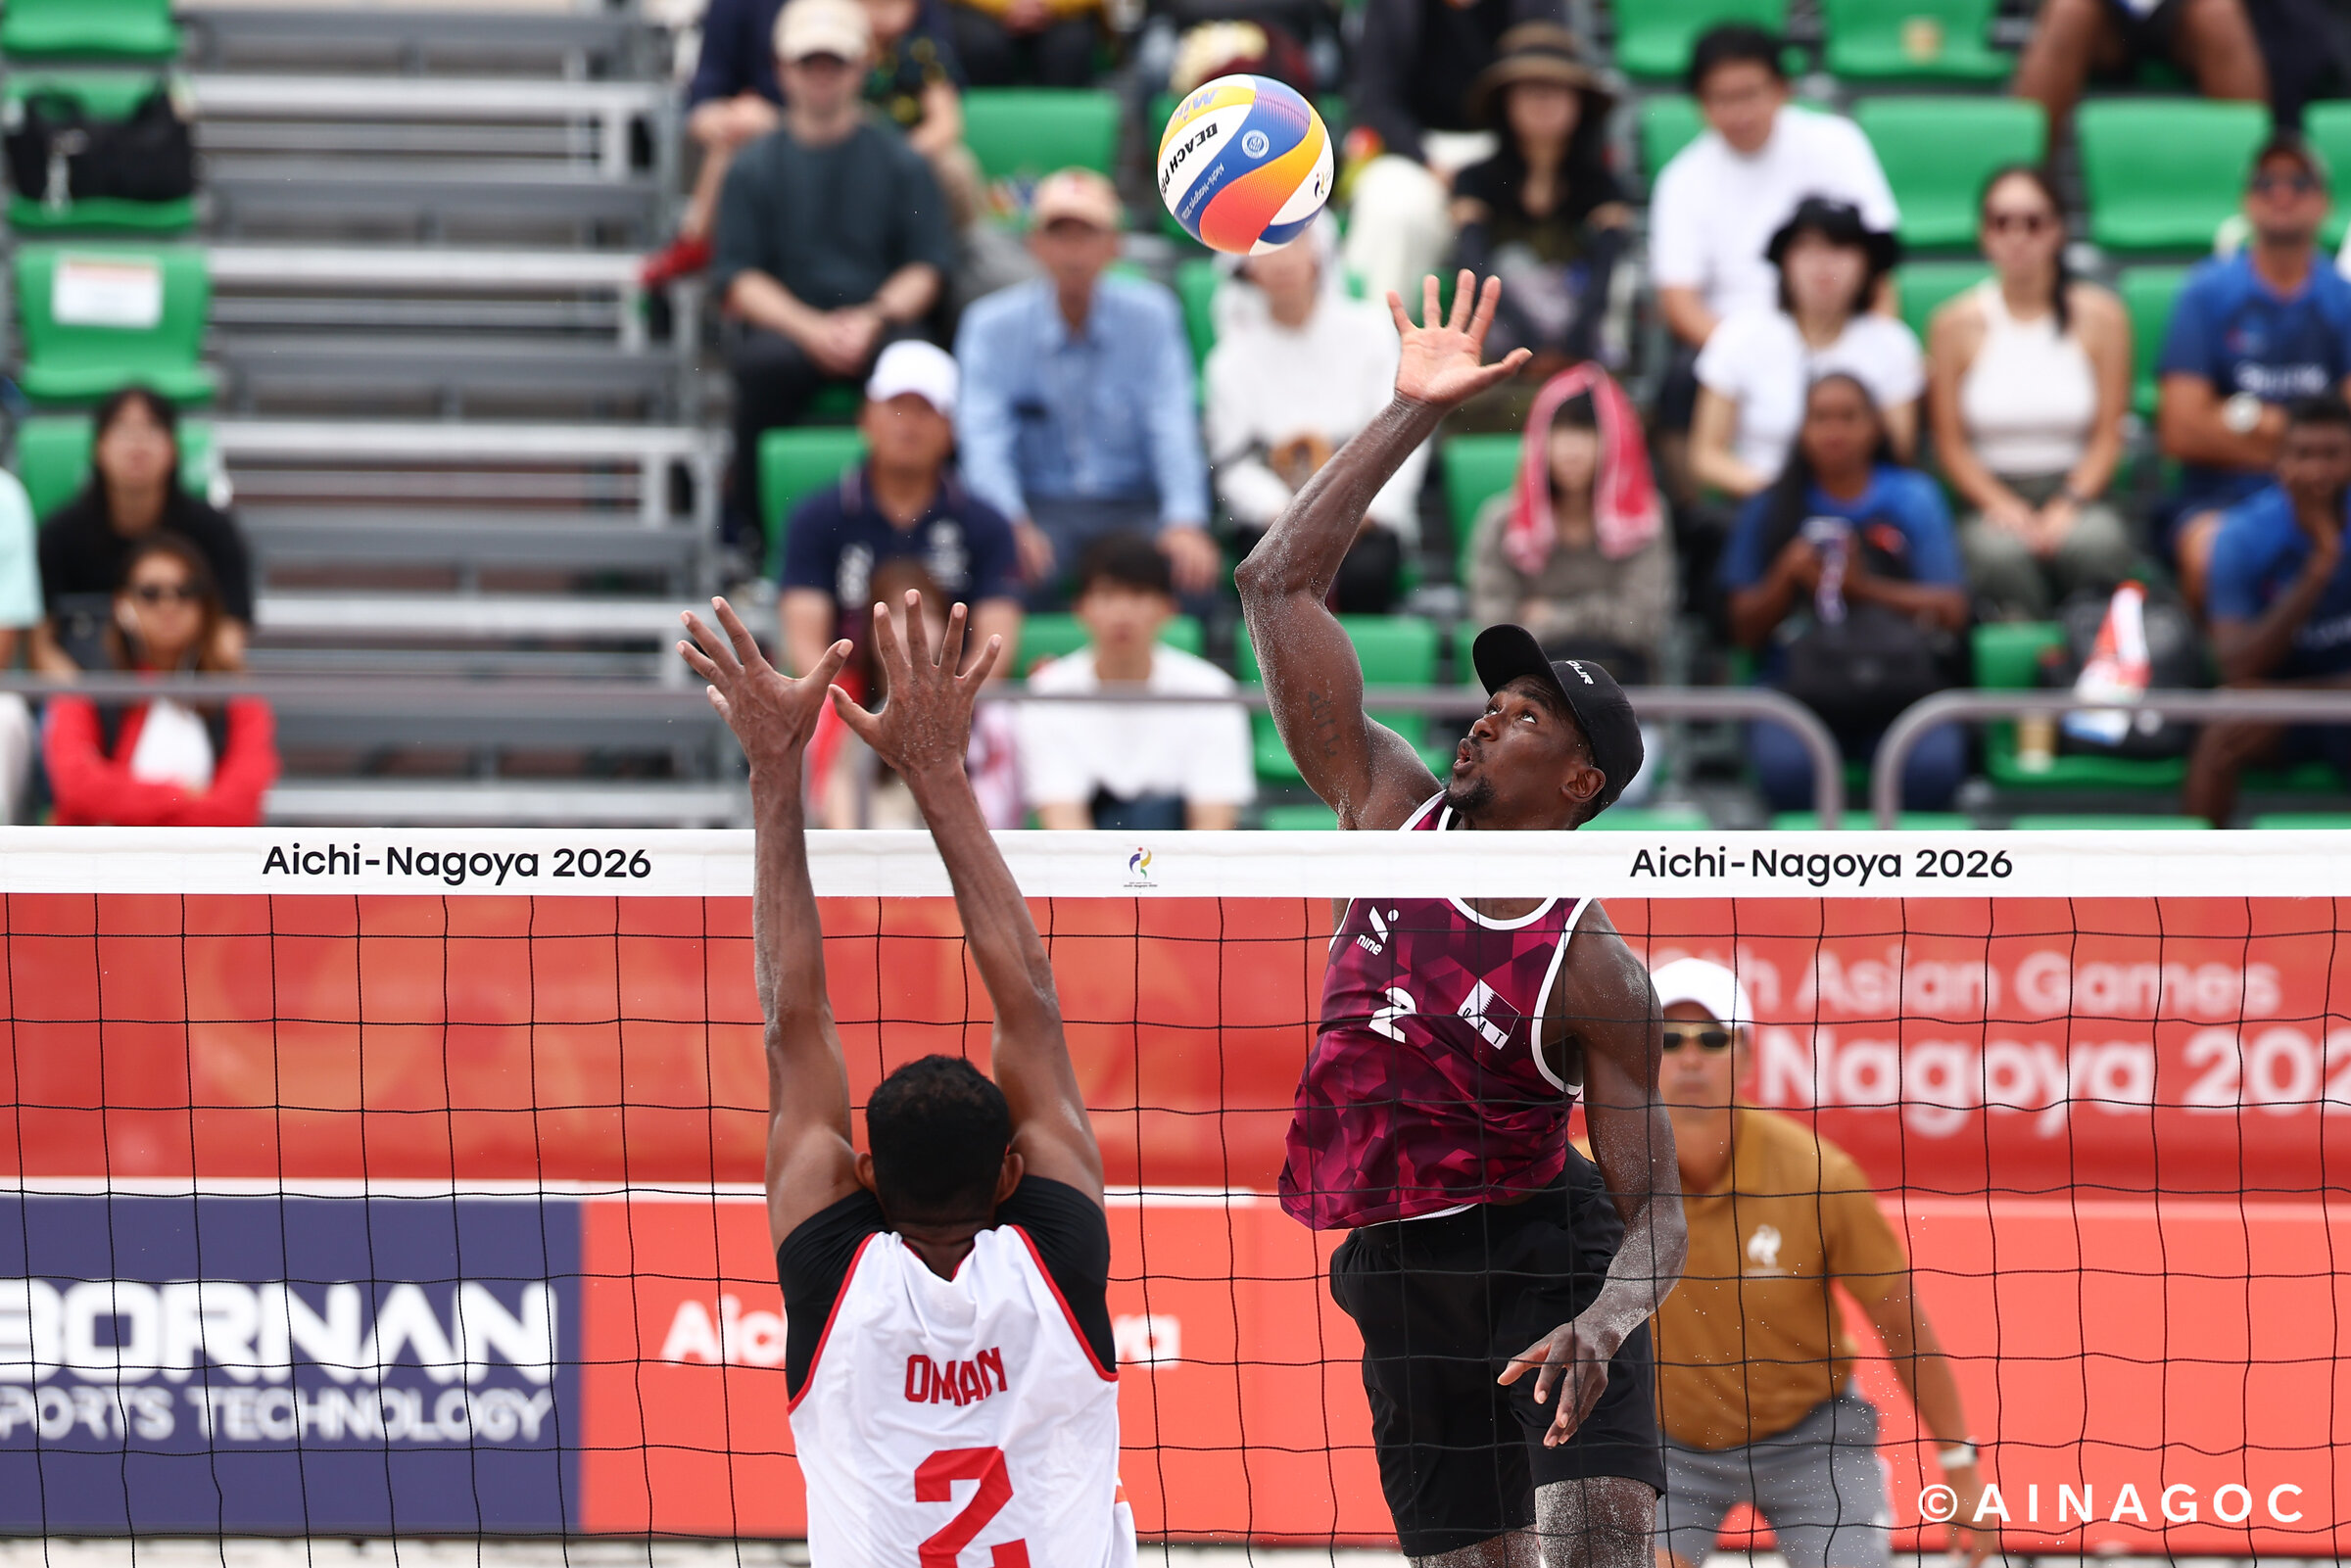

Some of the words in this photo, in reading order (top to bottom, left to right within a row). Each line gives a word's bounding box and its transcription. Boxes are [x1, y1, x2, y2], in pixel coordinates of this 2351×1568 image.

[1170, 122, 1218, 174] BEACH
[263, 843, 538, 885] Aichi-Nagoya
[552, 848, 651, 879] 2026
[1630, 846, 1900, 886] Aichi-Nagoya
[1915, 849, 2013, 879] 2026
[1356, 933, 1383, 956] nine
[1795, 946, 2000, 1015] Asian
[2015, 950, 2282, 1017] Games
[1368, 987, 1418, 1044] 2
[905, 1347, 1008, 1406] OMAN
[184, 1386, 552, 1443] TECHNOLOGY
[914, 1446, 1032, 1568] 2
